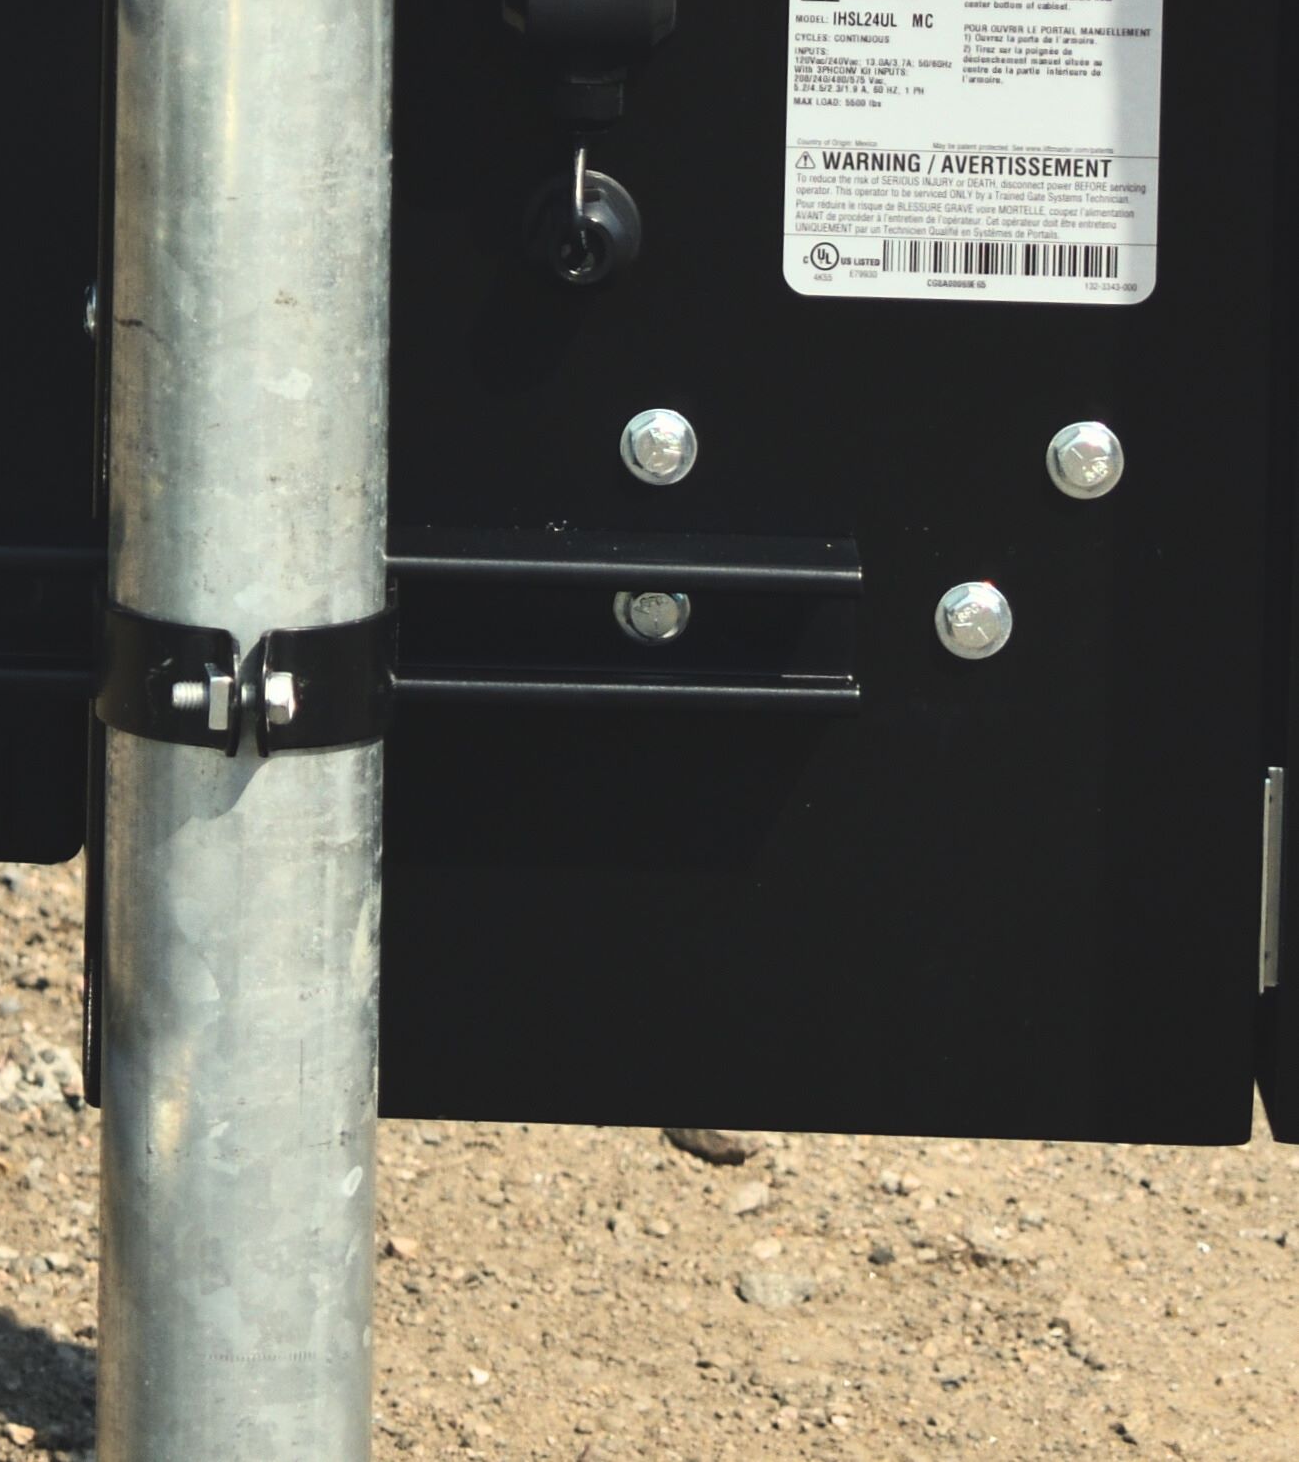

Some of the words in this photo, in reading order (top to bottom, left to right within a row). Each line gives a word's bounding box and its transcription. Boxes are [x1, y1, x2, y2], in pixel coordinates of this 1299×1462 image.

[832, 10, 897, 28] IHSL24UL
[911, 12, 933, 29] MC
[794, 32, 830, 42] CYCLES:
[833, 33, 890, 44] CONTINUOUS
[963, 23, 988, 33] POUR
[990, 24, 1024, 34] OUVRIR
[1026, 25, 1036, 34] LE
[1040, 25, 1076, 35] PORTAIL
[1079, 26, 1151, 37] MANUELLEMENT
[793, 96, 812, 105] MAX
[815, 97, 841, 106] LOAD:
[844, 98, 866, 107] 5500
[868, 99, 881, 108] lbs
[821, 150, 921, 173] WARNING
[927, 153, 935, 175] /
[940, 153, 1112, 179] AVERTISSEMENT
[796, 172, 807, 183] To
[808, 173, 837, 184] reduce
[837, 174, 852, 184] the
[853, 174, 869, 185] risk
[870, 174, 880, 185] of
[880, 174, 920, 186] SERIOUS
[921, 176, 954, 187] INJURY
[955, 178, 965, 188] or
[1000, 178, 1045, 190] disconnect
[1046, 181, 1072, 192] power
[1073, 180, 1107, 192] BEFORE
[1109, 181, 1147, 194] servicing
[834, 186, 853, 196] This
[854, 187, 889, 199] operator
[890, 187, 900, 197] to
[900, 188, 912, 198] be
[913, 188, 948, 199] serviced
[948, 189, 973, 199] ONLY
[974, 190, 985, 202] by
[986, 191, 992, 200] a
[994, 190, 1025, 201] Trained
[1026, 191, 1046, 202] Gate
[1046, 192, 1083, 204] Systems
[838, 256, 852, 265] US
[853, 257, 881, 266] LISTED
